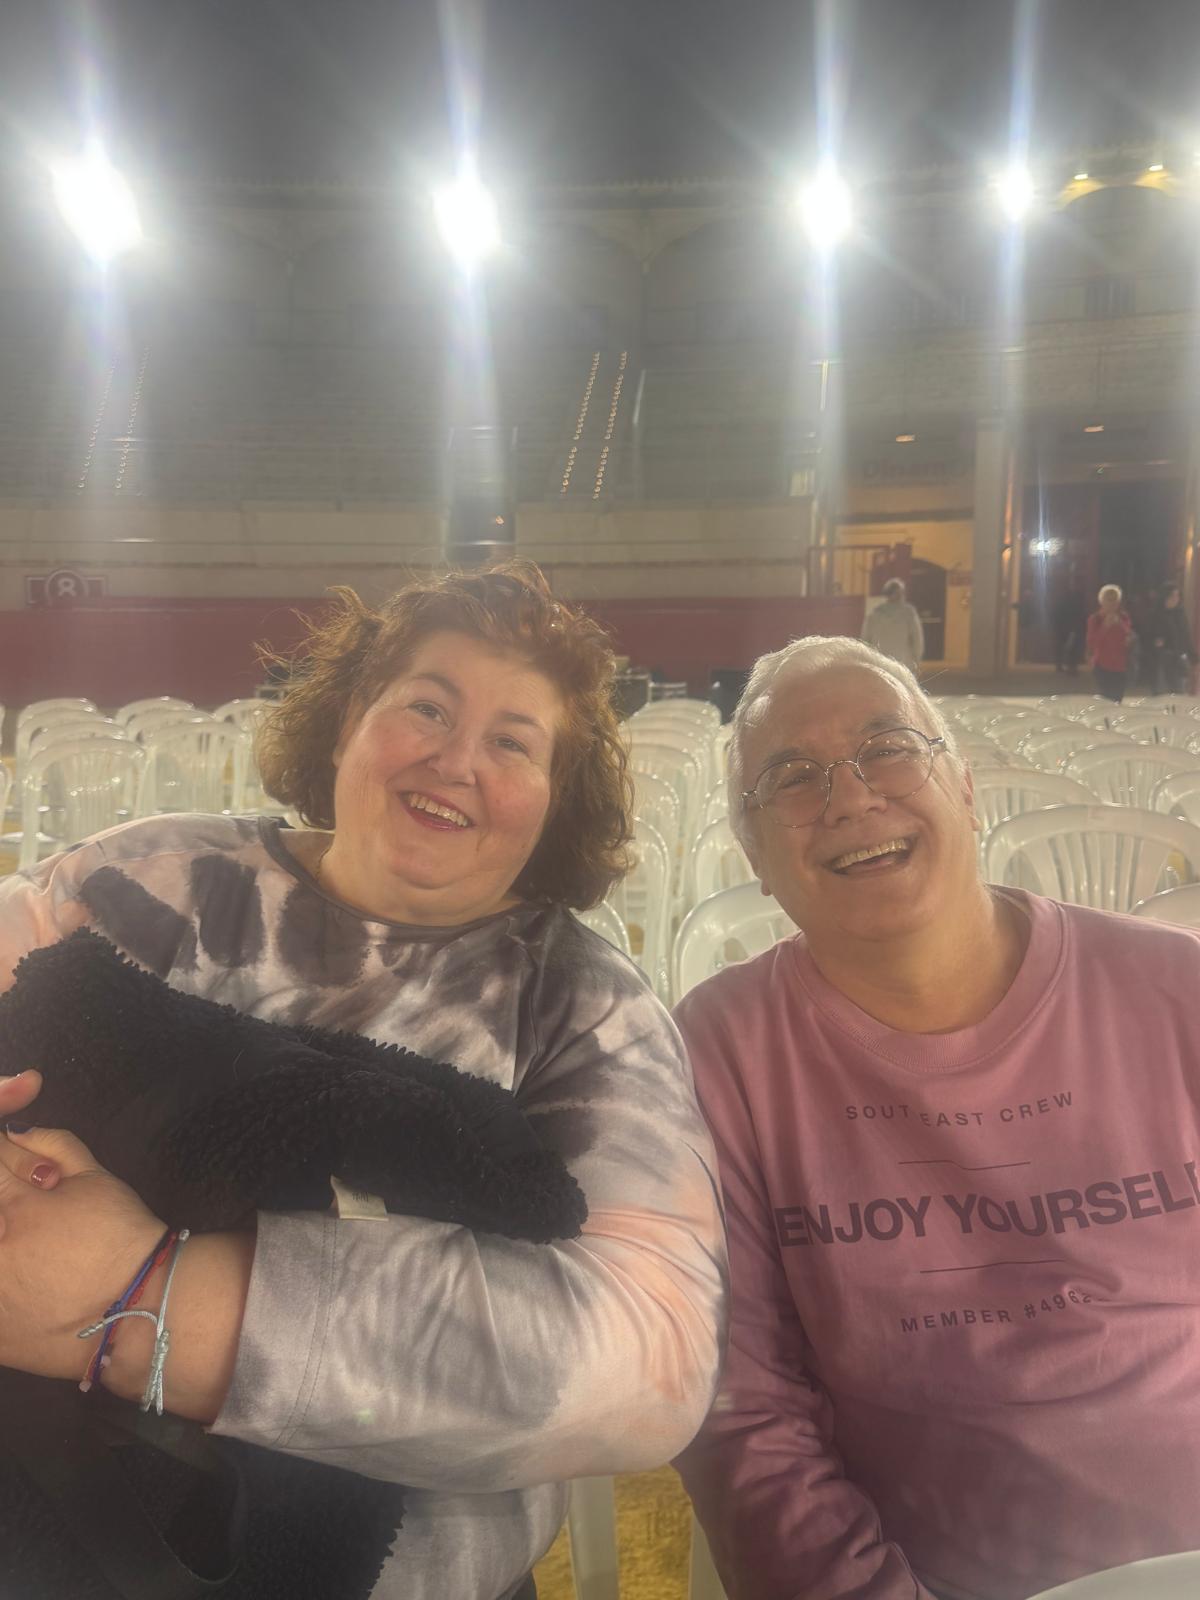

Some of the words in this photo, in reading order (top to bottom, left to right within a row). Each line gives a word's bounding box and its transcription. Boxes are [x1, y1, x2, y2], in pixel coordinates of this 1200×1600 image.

[1000, 1092, 1073, 1123] CREW
[774, 1196, 931, 1247] ENJOY
[901, 1308, 1011, 1333] MEMBER
